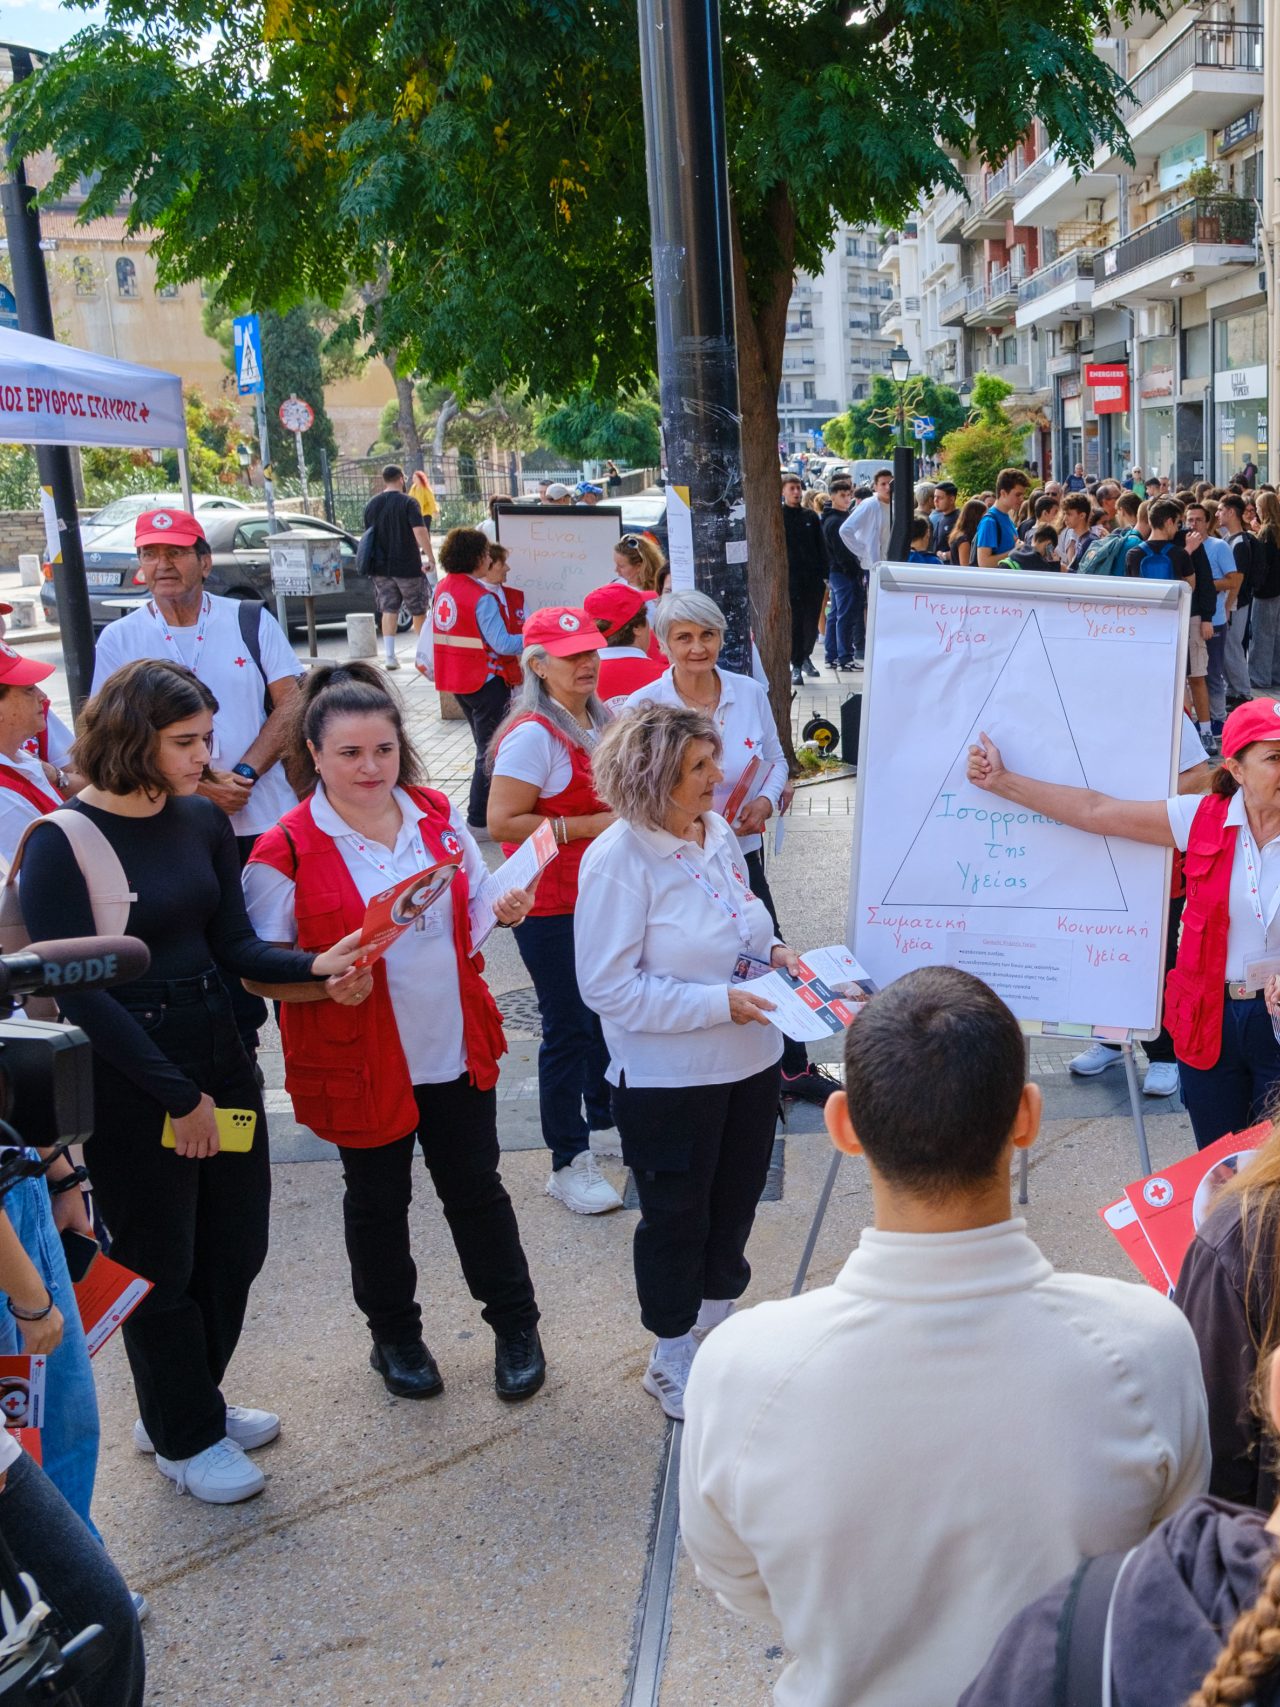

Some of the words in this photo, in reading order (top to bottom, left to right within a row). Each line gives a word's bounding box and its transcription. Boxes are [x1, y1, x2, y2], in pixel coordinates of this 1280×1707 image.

[26, 387, 87, 417] ΕΡΥΘΡΟΣ
[87, 395, 140, 423] ΣΤΑΥΡΟΣ
[936, 621, 987, 653] Υγεία
[1086, 618, 1137, 638] Υγείας
[984, 843, 1027, 859] της
[957, 861, 1028, 895] Υγείας
[866, 906, 967, 933] Σωματική
[1057, 915, 1149, 938] Κοινωνική
[893, 932, 935, 954] Υγεία
[1086, 944, 1132, 967] Υγεία
[43, 953, 118, 986] RØDE
